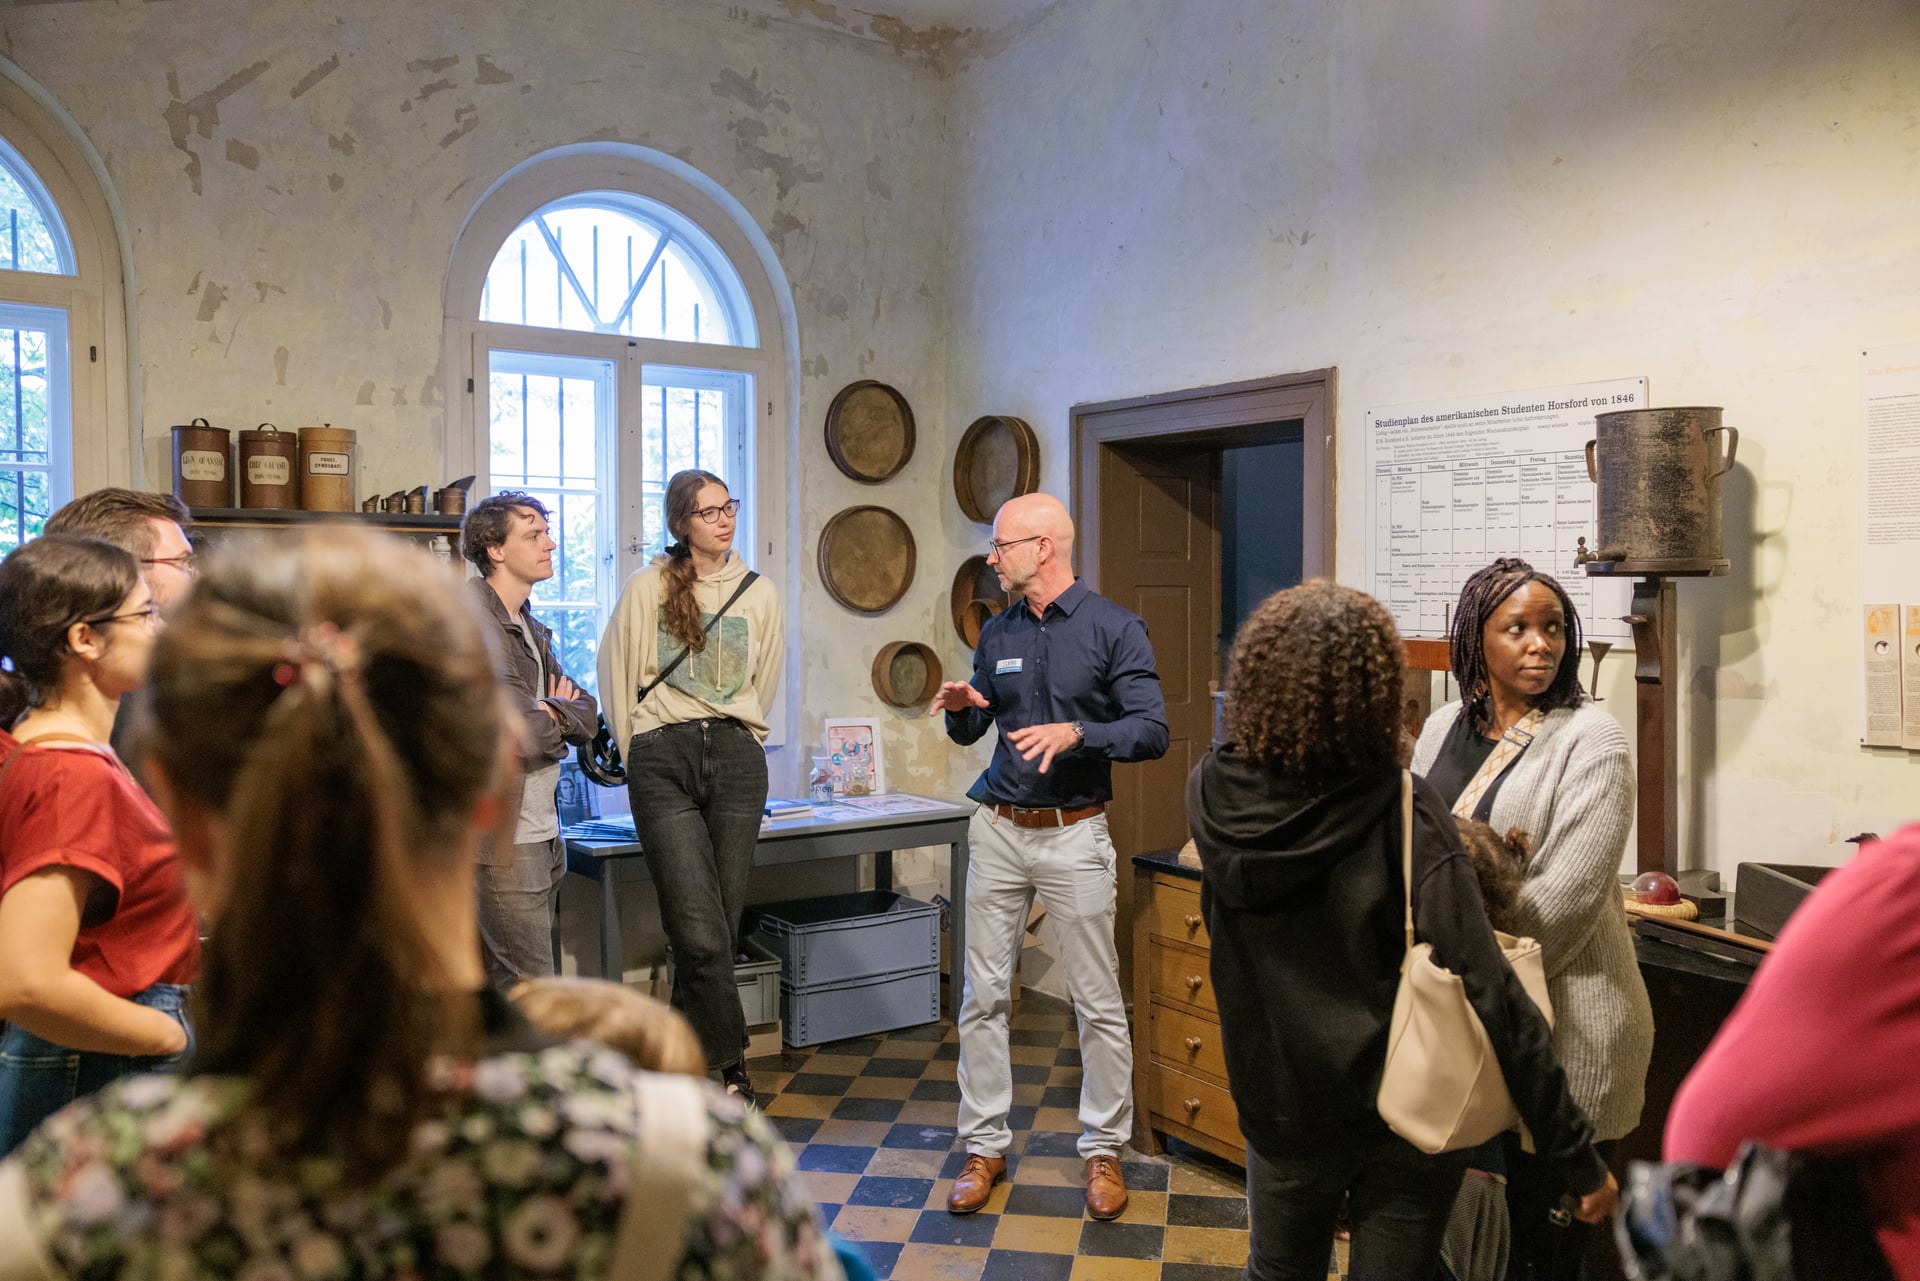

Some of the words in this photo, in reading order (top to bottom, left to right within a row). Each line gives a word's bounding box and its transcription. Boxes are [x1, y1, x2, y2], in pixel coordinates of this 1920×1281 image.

[1375, 416, 1419, 428] Studienplan
[1420, 414, 1434, 424] des
[1435, 407, 1499, 421] amerikanischen
[1501, 403, 1545, 416] Studenten
[1548, 397, 1588, 411] Horsford
[1590, 398, 1608, 406] von
[1611, 393, 1635, 404] 1846
